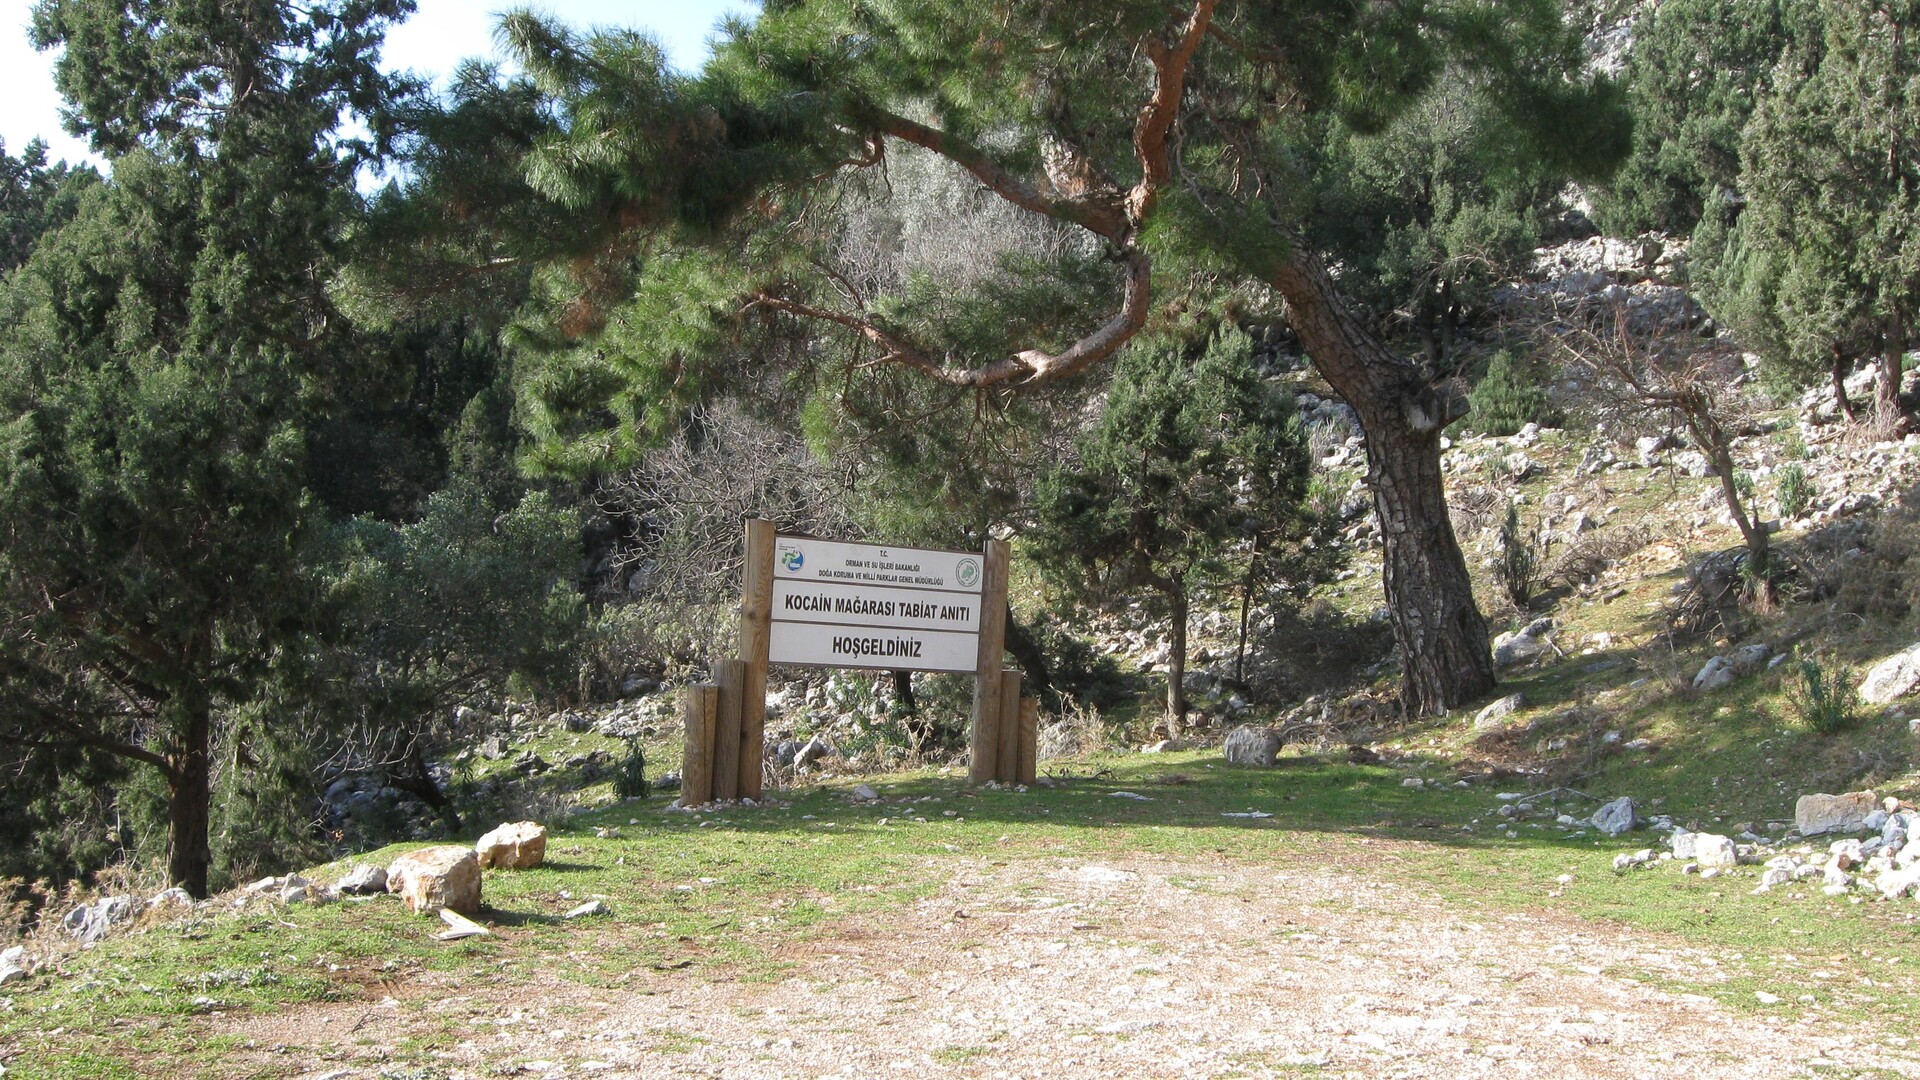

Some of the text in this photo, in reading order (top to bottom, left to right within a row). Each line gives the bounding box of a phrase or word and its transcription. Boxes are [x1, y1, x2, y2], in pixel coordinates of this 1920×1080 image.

[845, 559, 863, 568] ORMAN
[871, 561, 878, 569] SU
[879, 560, 894, 571] İŞLERİ
[895, 563, 920, 572] BAKANLIĞI
[819, 568, 832, 577] DOĞA
[833, 570, 854, 579] KORUMA
[862, 571, 875, 580] MİLLİ
[876, 574, 898, 583] PARKLAR
[899, 576, 914, 584] GENEL
[914, 576, 944, 586] MÜDÜRLÜĞÜ
[785, 593, 970, 621] KOCAİN MAĞARASI TABİAT ANITI
[832, 636, 922, 659] HOŞGELDİNİZ
